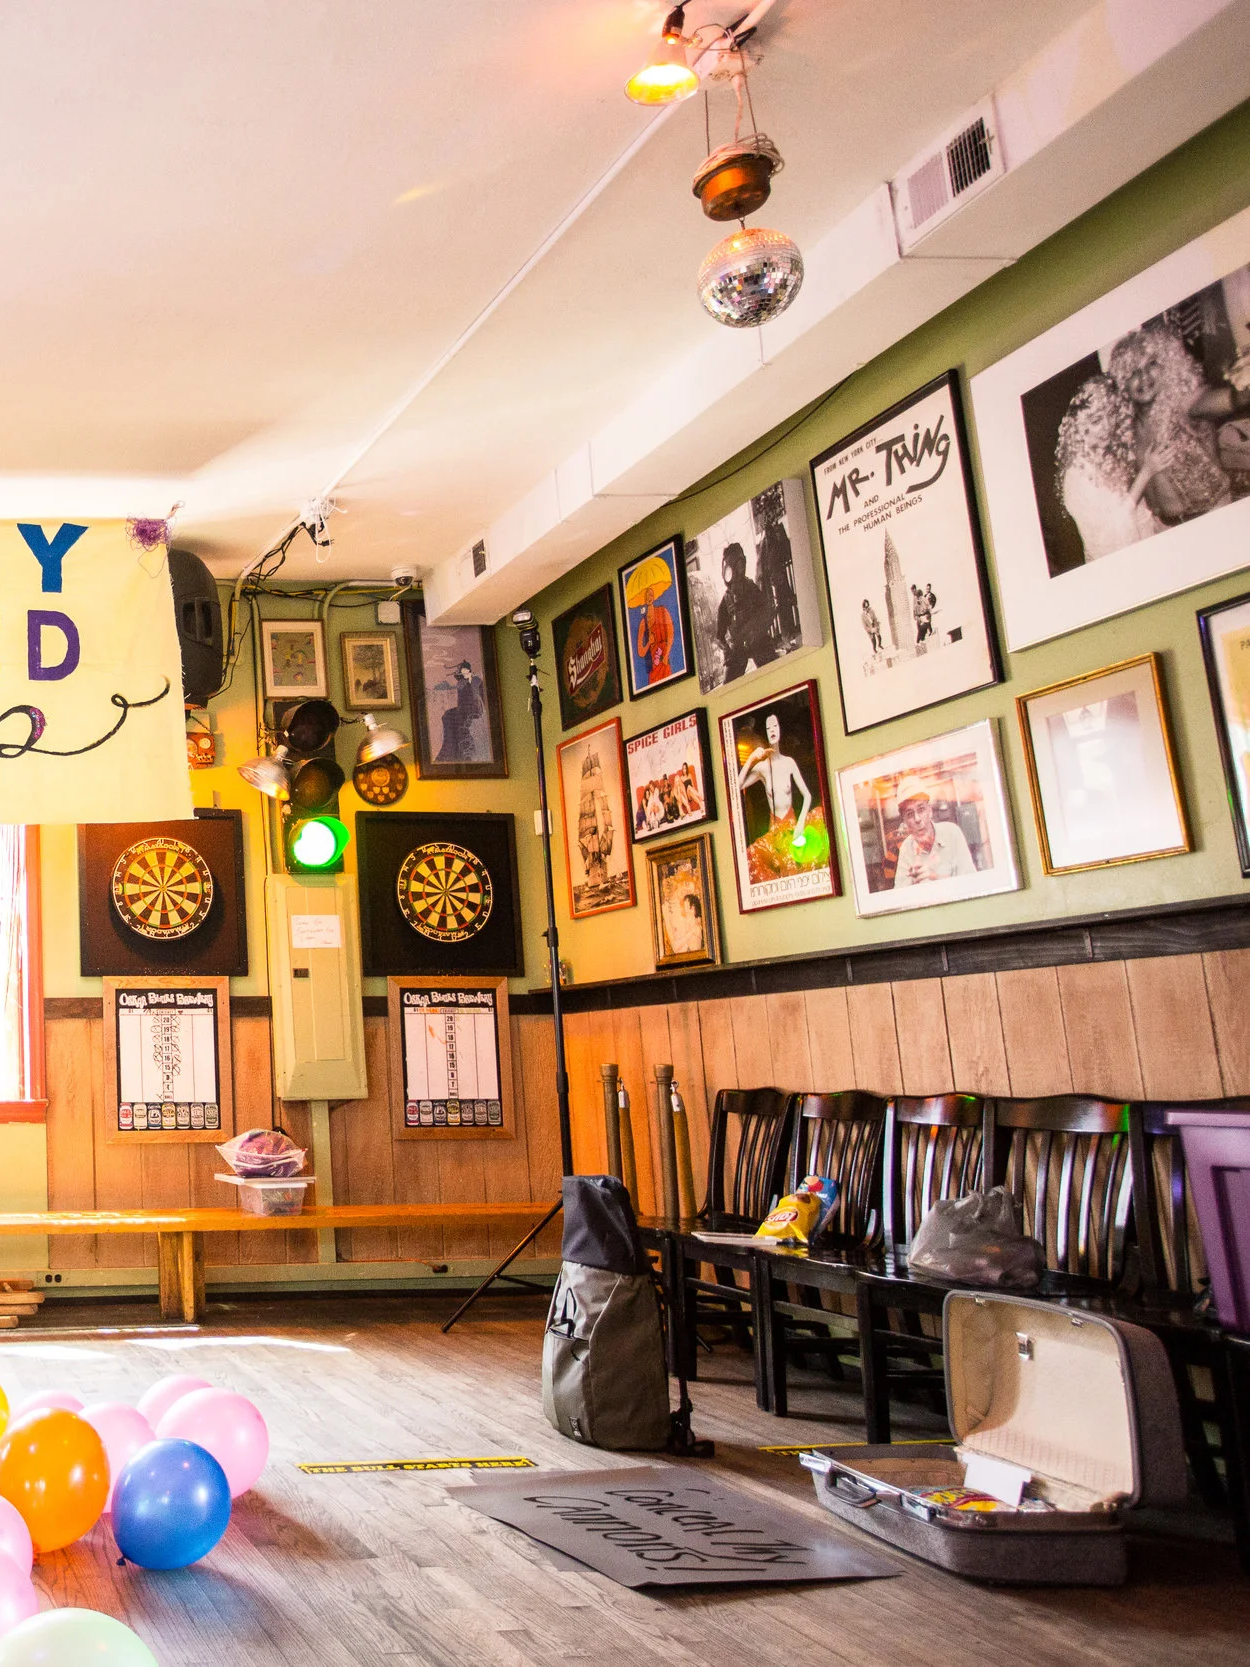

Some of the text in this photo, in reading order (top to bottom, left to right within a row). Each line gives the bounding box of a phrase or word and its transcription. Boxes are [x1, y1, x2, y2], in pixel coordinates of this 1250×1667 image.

[824, 462, 837, 475] FROM
[838, 455, 849, 467] NEW
[851, 448, 864, 460] YORK
[826, 467, 875, 520] MR.
[864, 494, 879, 508] AND
[838, 493, 905, 535] THE PROFESSIONAL
[863, 494, 923, 532] HUMAN BEINGS
[627, 715, 697, 755] SPICE GIRLS
[309, 1460, 527, 1474] THE BULL STARTS HERE
